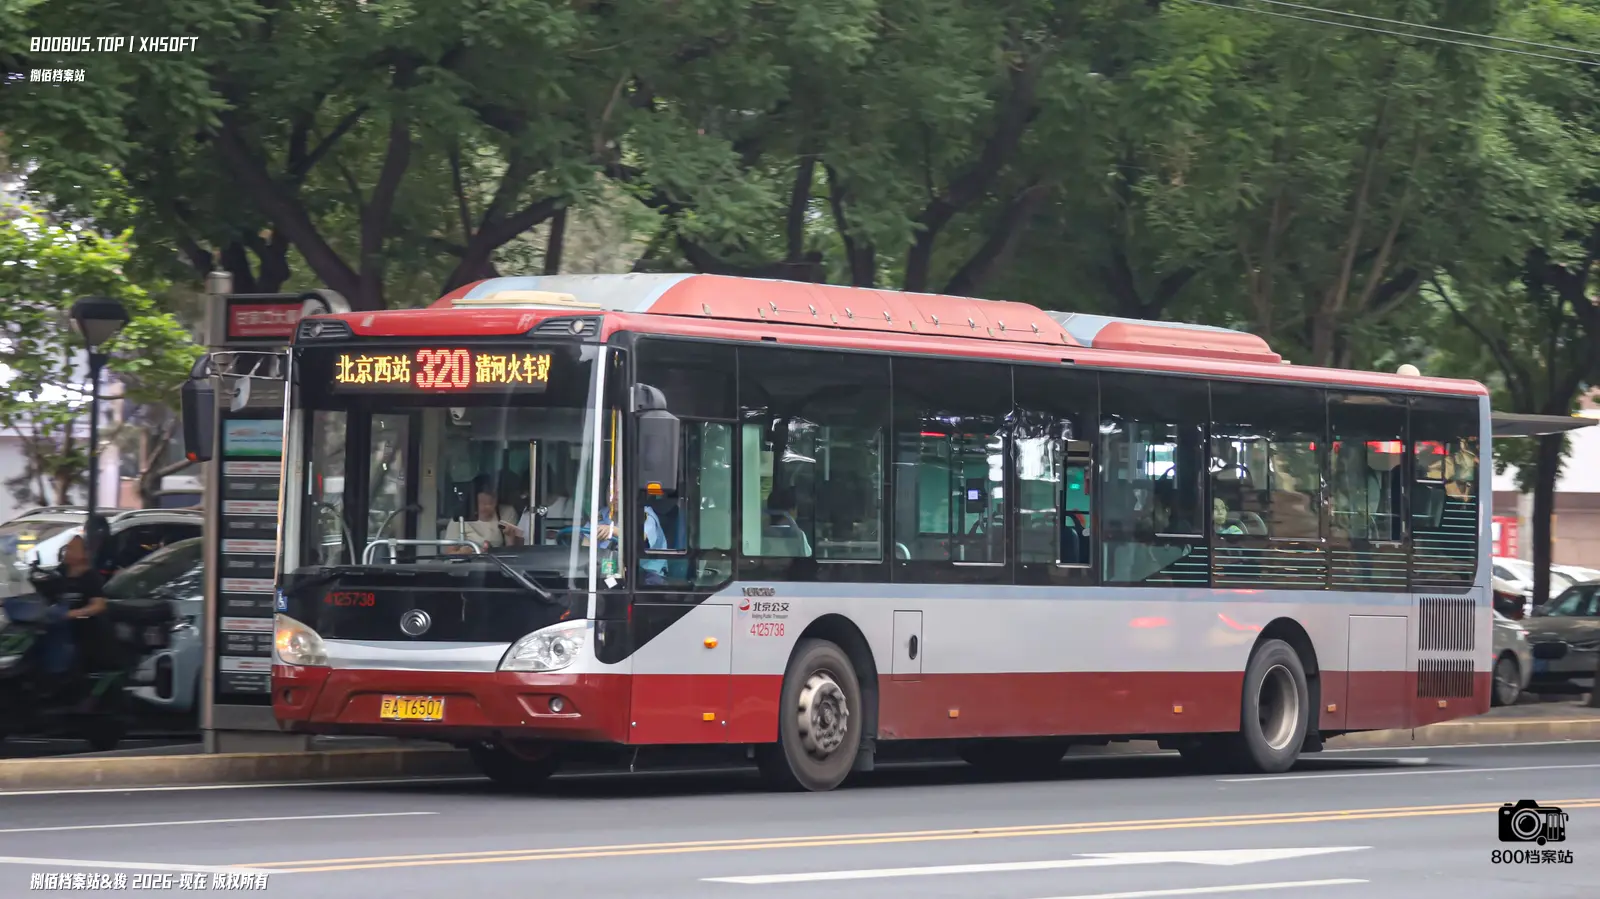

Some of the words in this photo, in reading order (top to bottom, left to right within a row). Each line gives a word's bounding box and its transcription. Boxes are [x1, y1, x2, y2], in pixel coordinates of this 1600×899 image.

[336, 354, 411, 384] 北京西站
[416, 349, 471, 388] 320
[475, 353, 551, 383] 清河火车站
[324, 592, 375, 607] 4125738
[753, 602, 790, 612] 北京公交
[750, 622, 785, 637] 4125738
